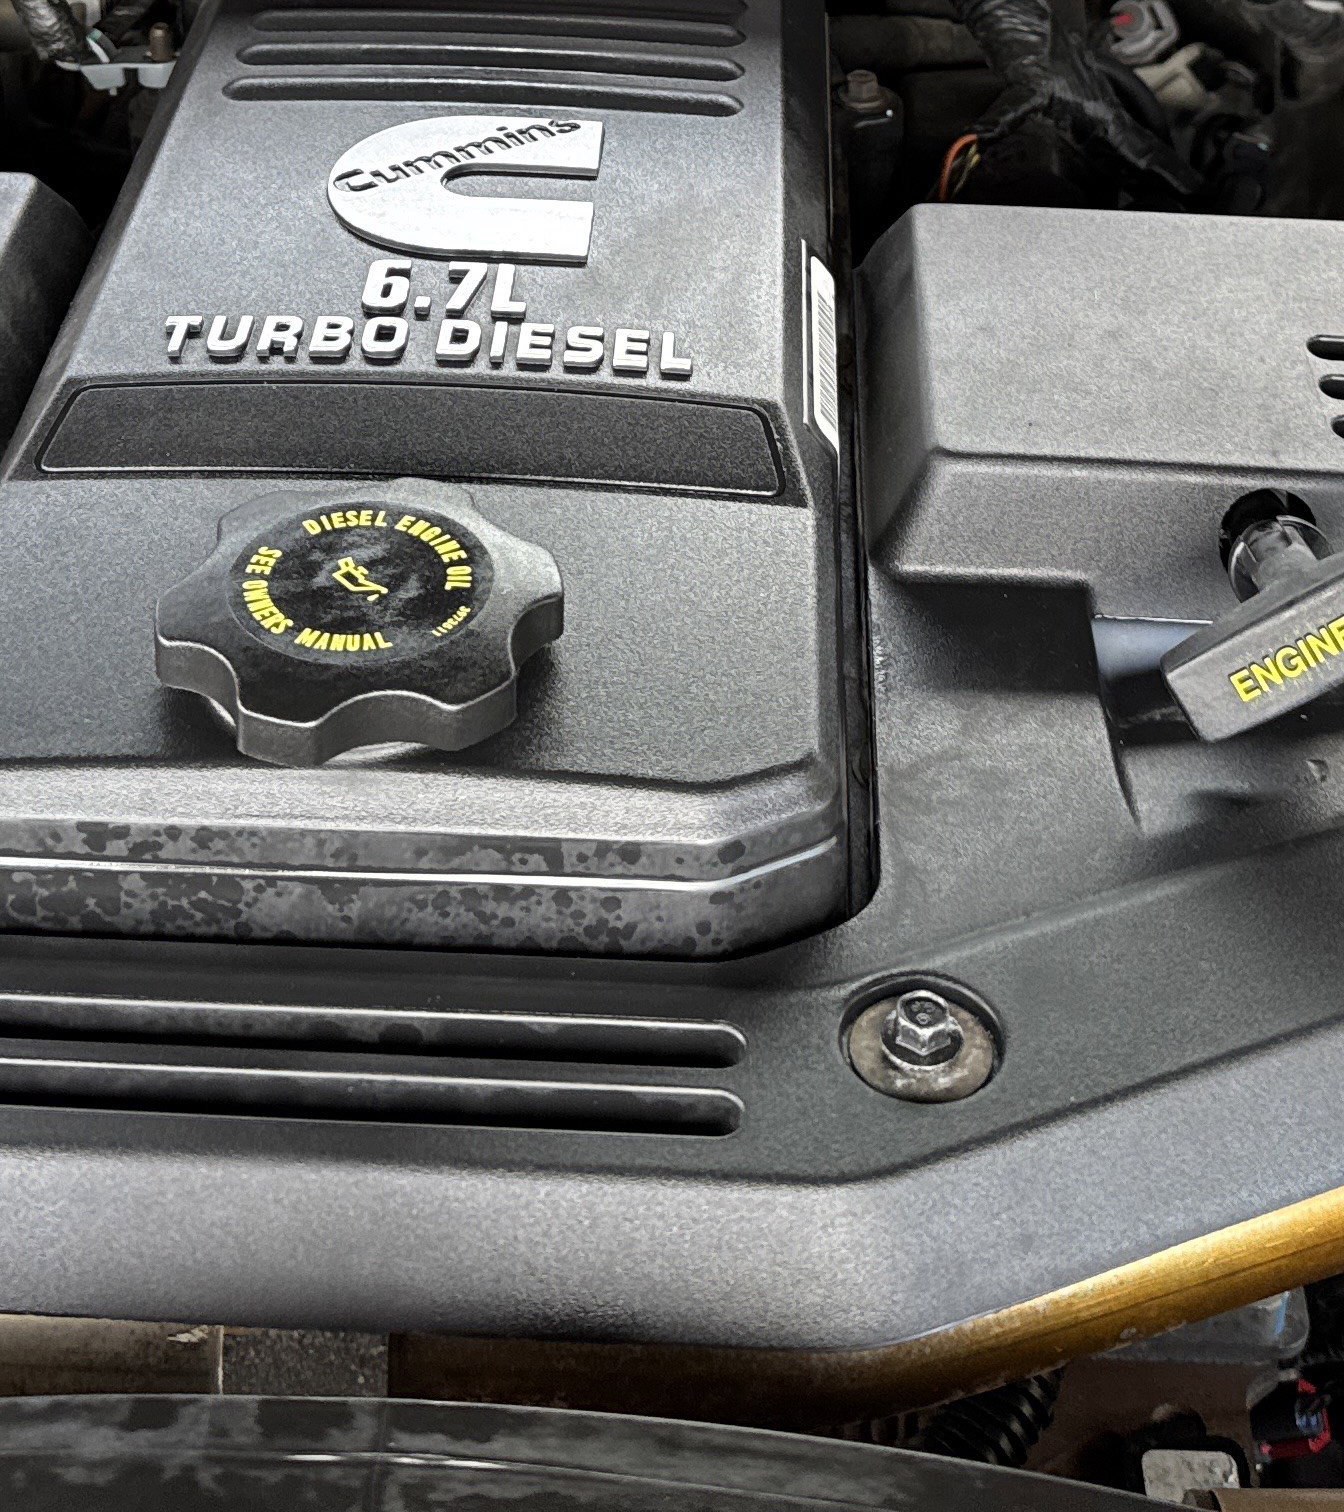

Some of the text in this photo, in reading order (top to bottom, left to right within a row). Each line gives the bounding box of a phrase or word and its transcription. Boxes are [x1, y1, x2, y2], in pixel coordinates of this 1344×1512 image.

[332, 118, 582, 192] Cummins
[361, 259, 527, 319] 6.7L
[164, 314, 693, 380] TURBO DIESEL
[301, 509, 473, 591] DIESEL ENGINE OIL
[242, 546, 393, 652] SEE OWNERS MANUAL
